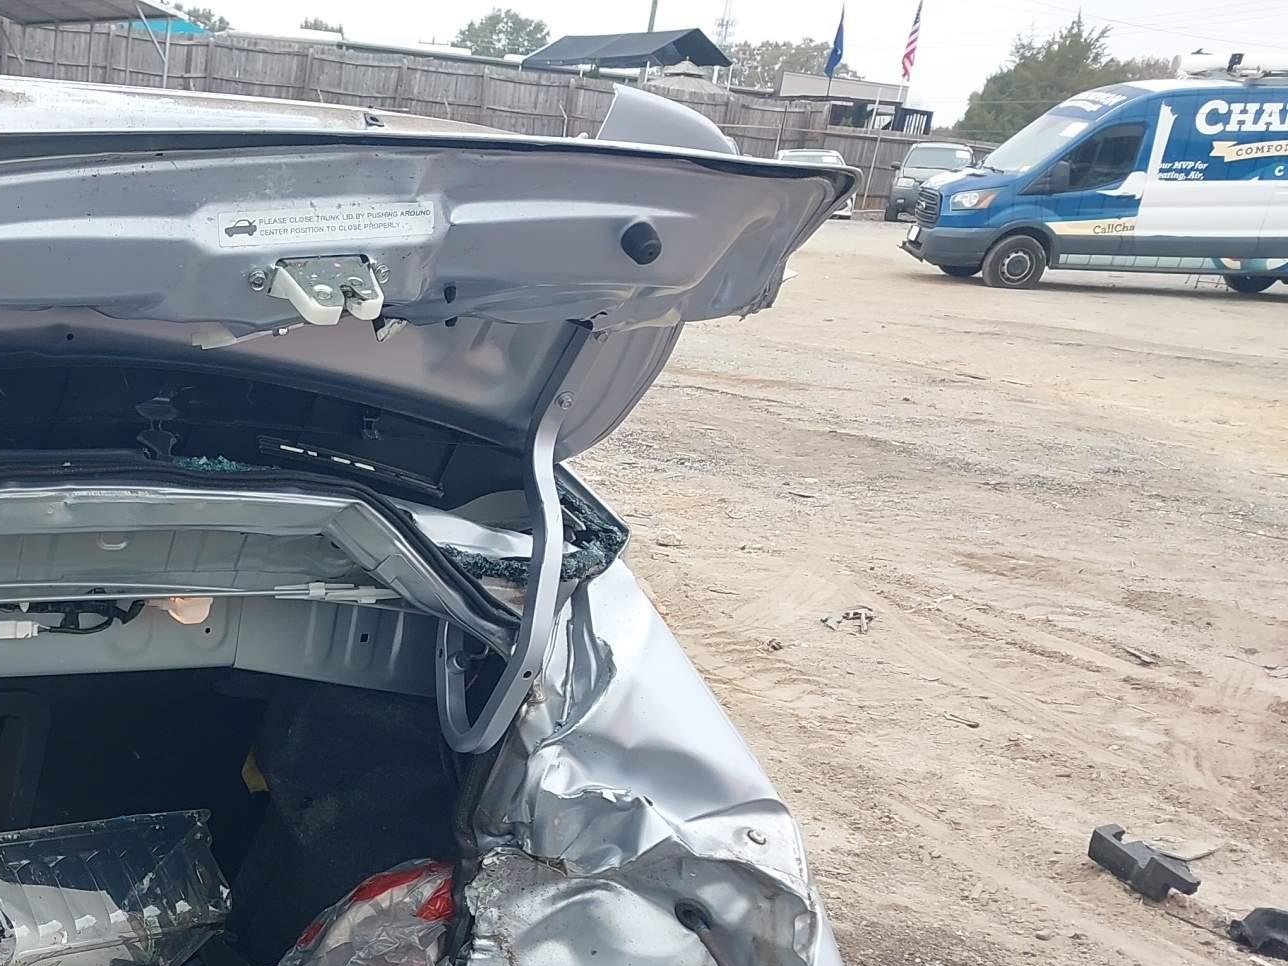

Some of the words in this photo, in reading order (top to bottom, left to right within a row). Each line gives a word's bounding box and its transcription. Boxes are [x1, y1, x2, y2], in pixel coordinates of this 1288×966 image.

[1195, 99, 1288, 135] CHA
[1173, 161, 1194, 169] MVP
[1194, 160, 1208, 169] for
[1187, 171, 1204, 180] Air,
[259, 217, 287, 225] PLEASE
[289, 215, 313, 223] CLOSE
[316, 214, 340, 222] TRUNK
[367, 211, 398, 219] PUSHING
[400, 209, 431, 217] AROUND
[259, 228, 289, 236] CENTER
[290, 225, 324, 234] POSITION
[338, 223, 362, 232] CLOSE
[364, 222, 400, 231] PROPERLY
